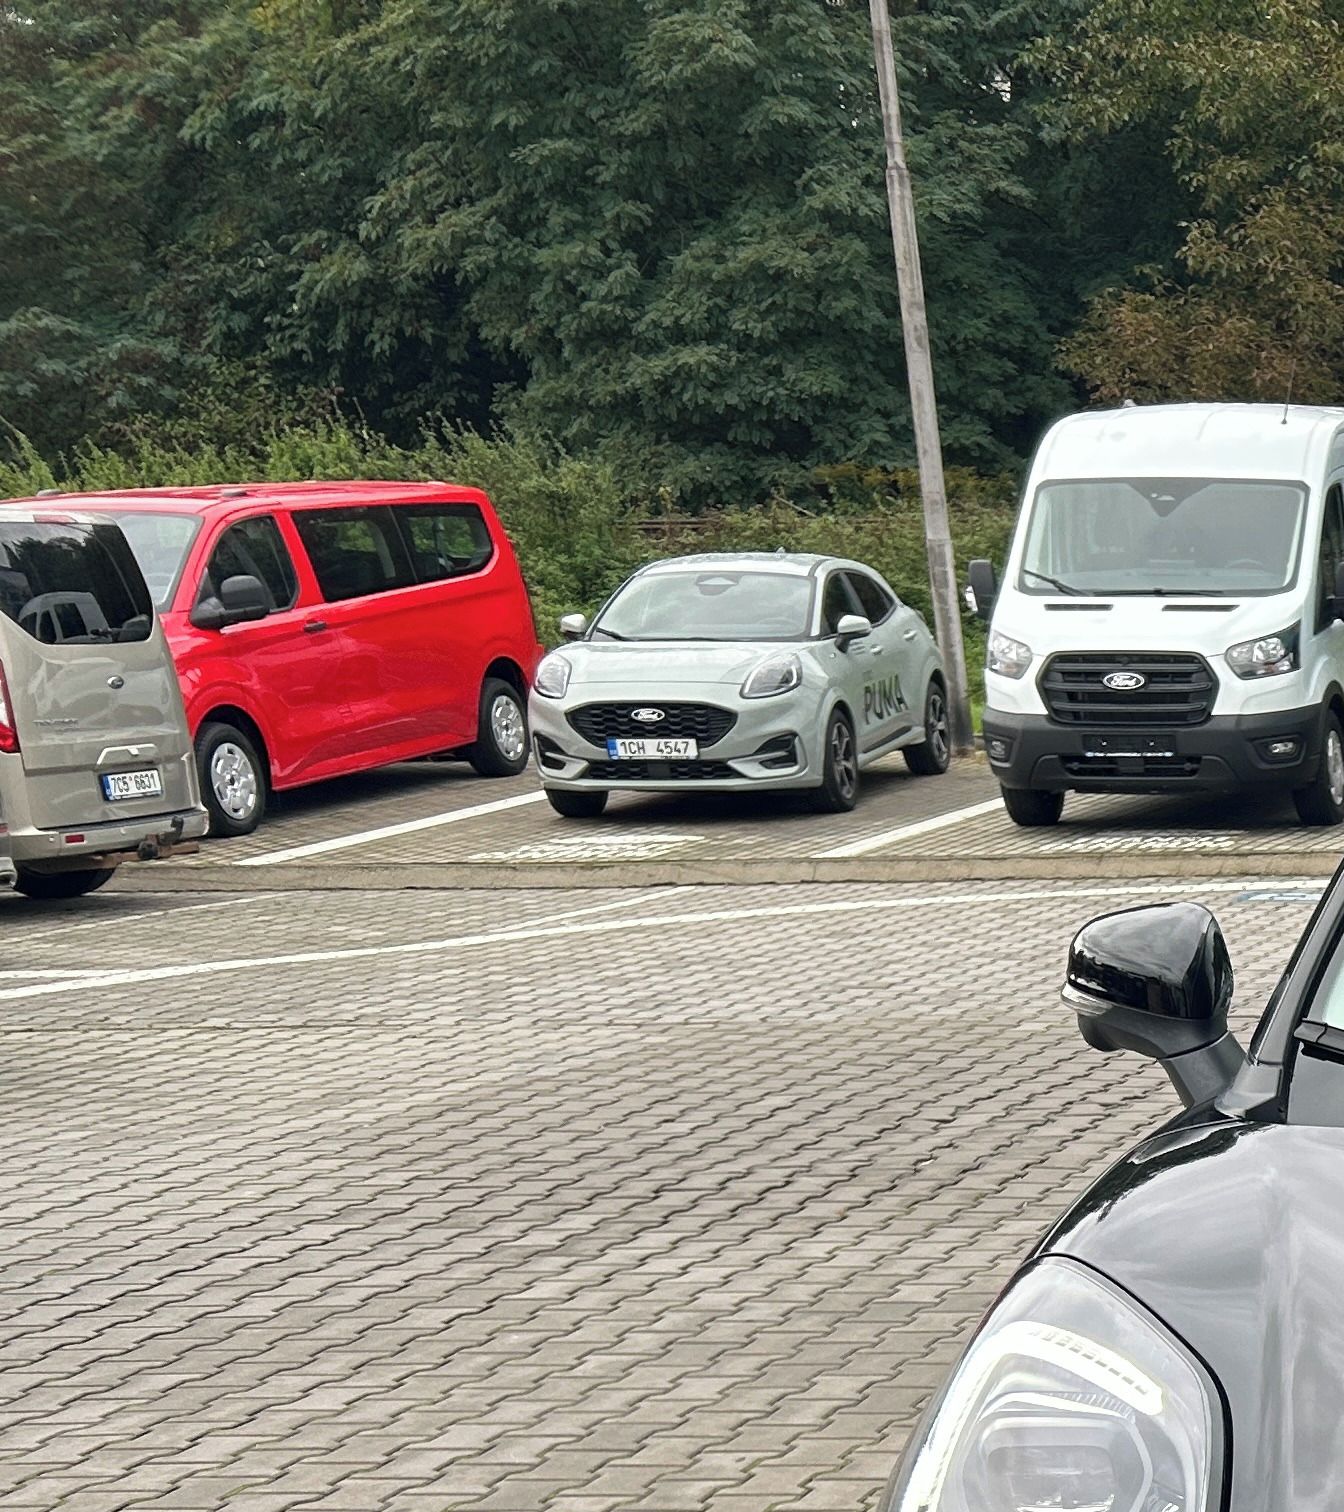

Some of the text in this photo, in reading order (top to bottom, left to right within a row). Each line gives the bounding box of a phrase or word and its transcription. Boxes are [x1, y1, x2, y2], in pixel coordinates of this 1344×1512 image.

[864, 673, 910, 725] PUMA
[620, 741, 690, 755] 1CH 4547
